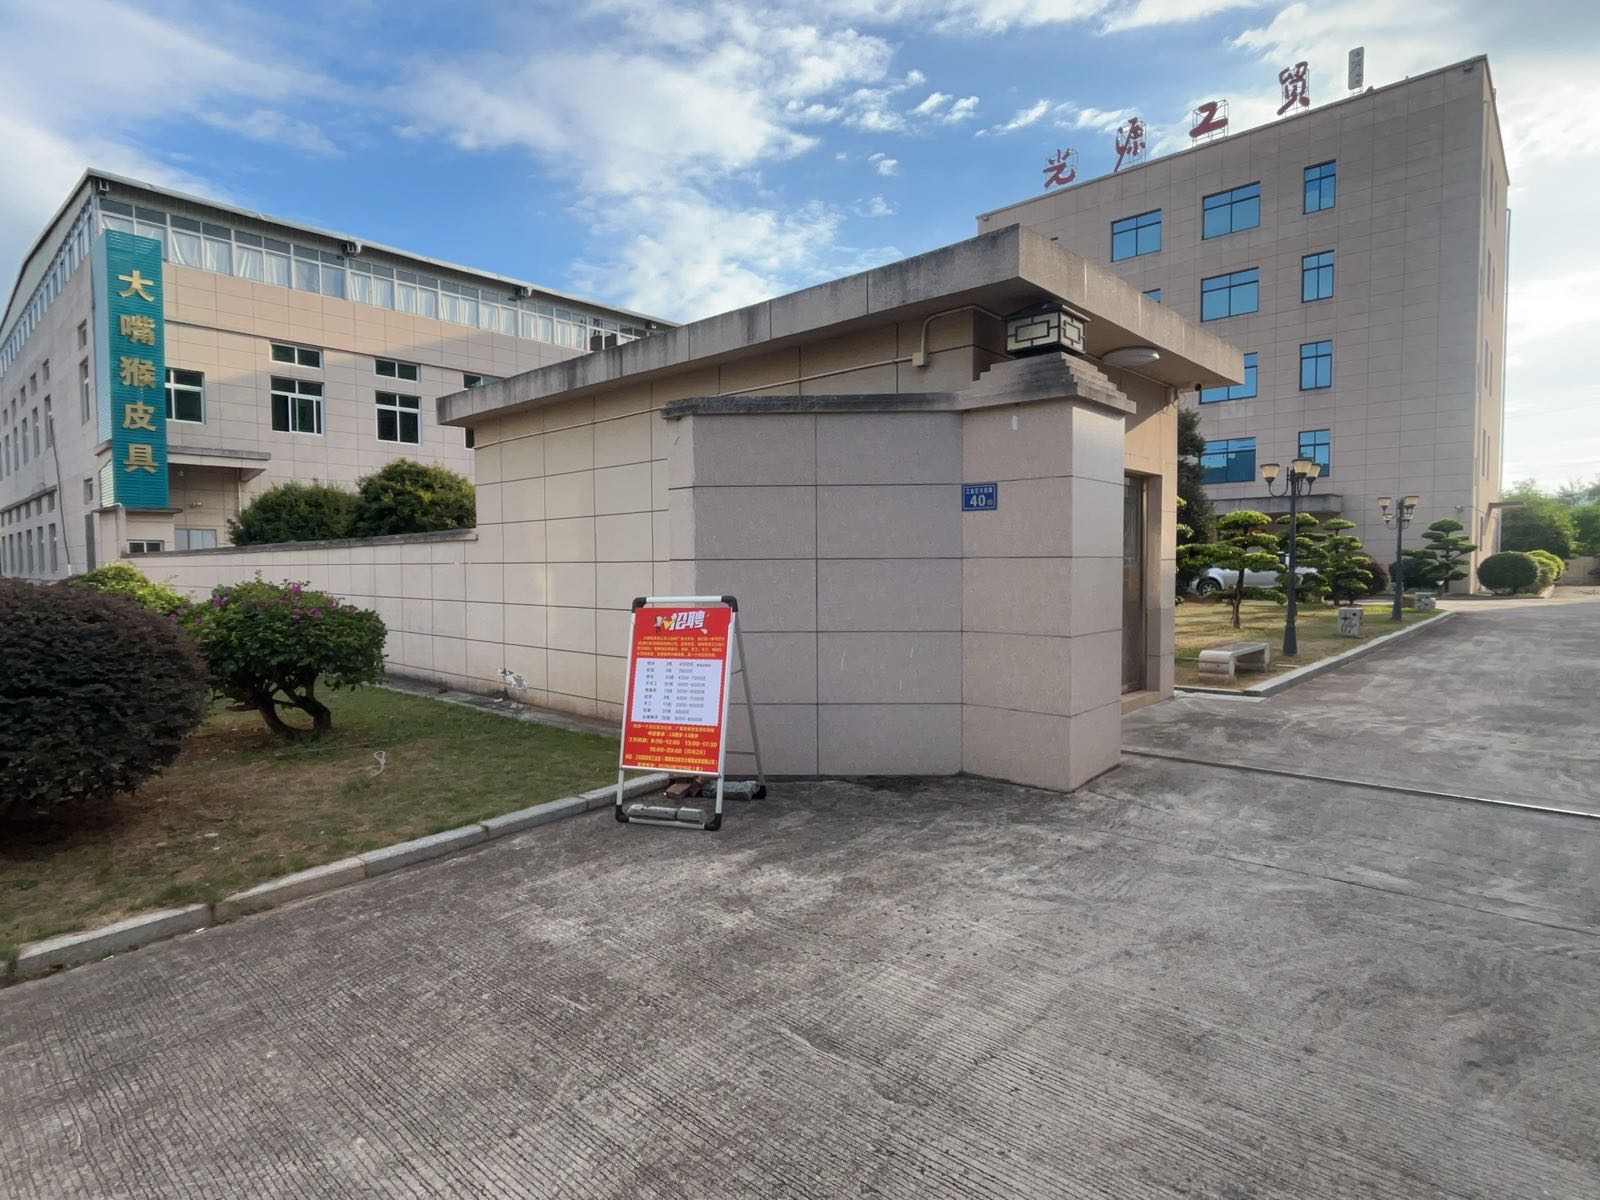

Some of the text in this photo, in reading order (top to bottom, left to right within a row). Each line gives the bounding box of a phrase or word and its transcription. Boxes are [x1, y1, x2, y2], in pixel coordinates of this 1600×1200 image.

[1043, 61, 1311, 188] 光源工贸
[118, 269, 158, 473] 大嘴猴皮具
[668, 610, 706, 631] 招聘
